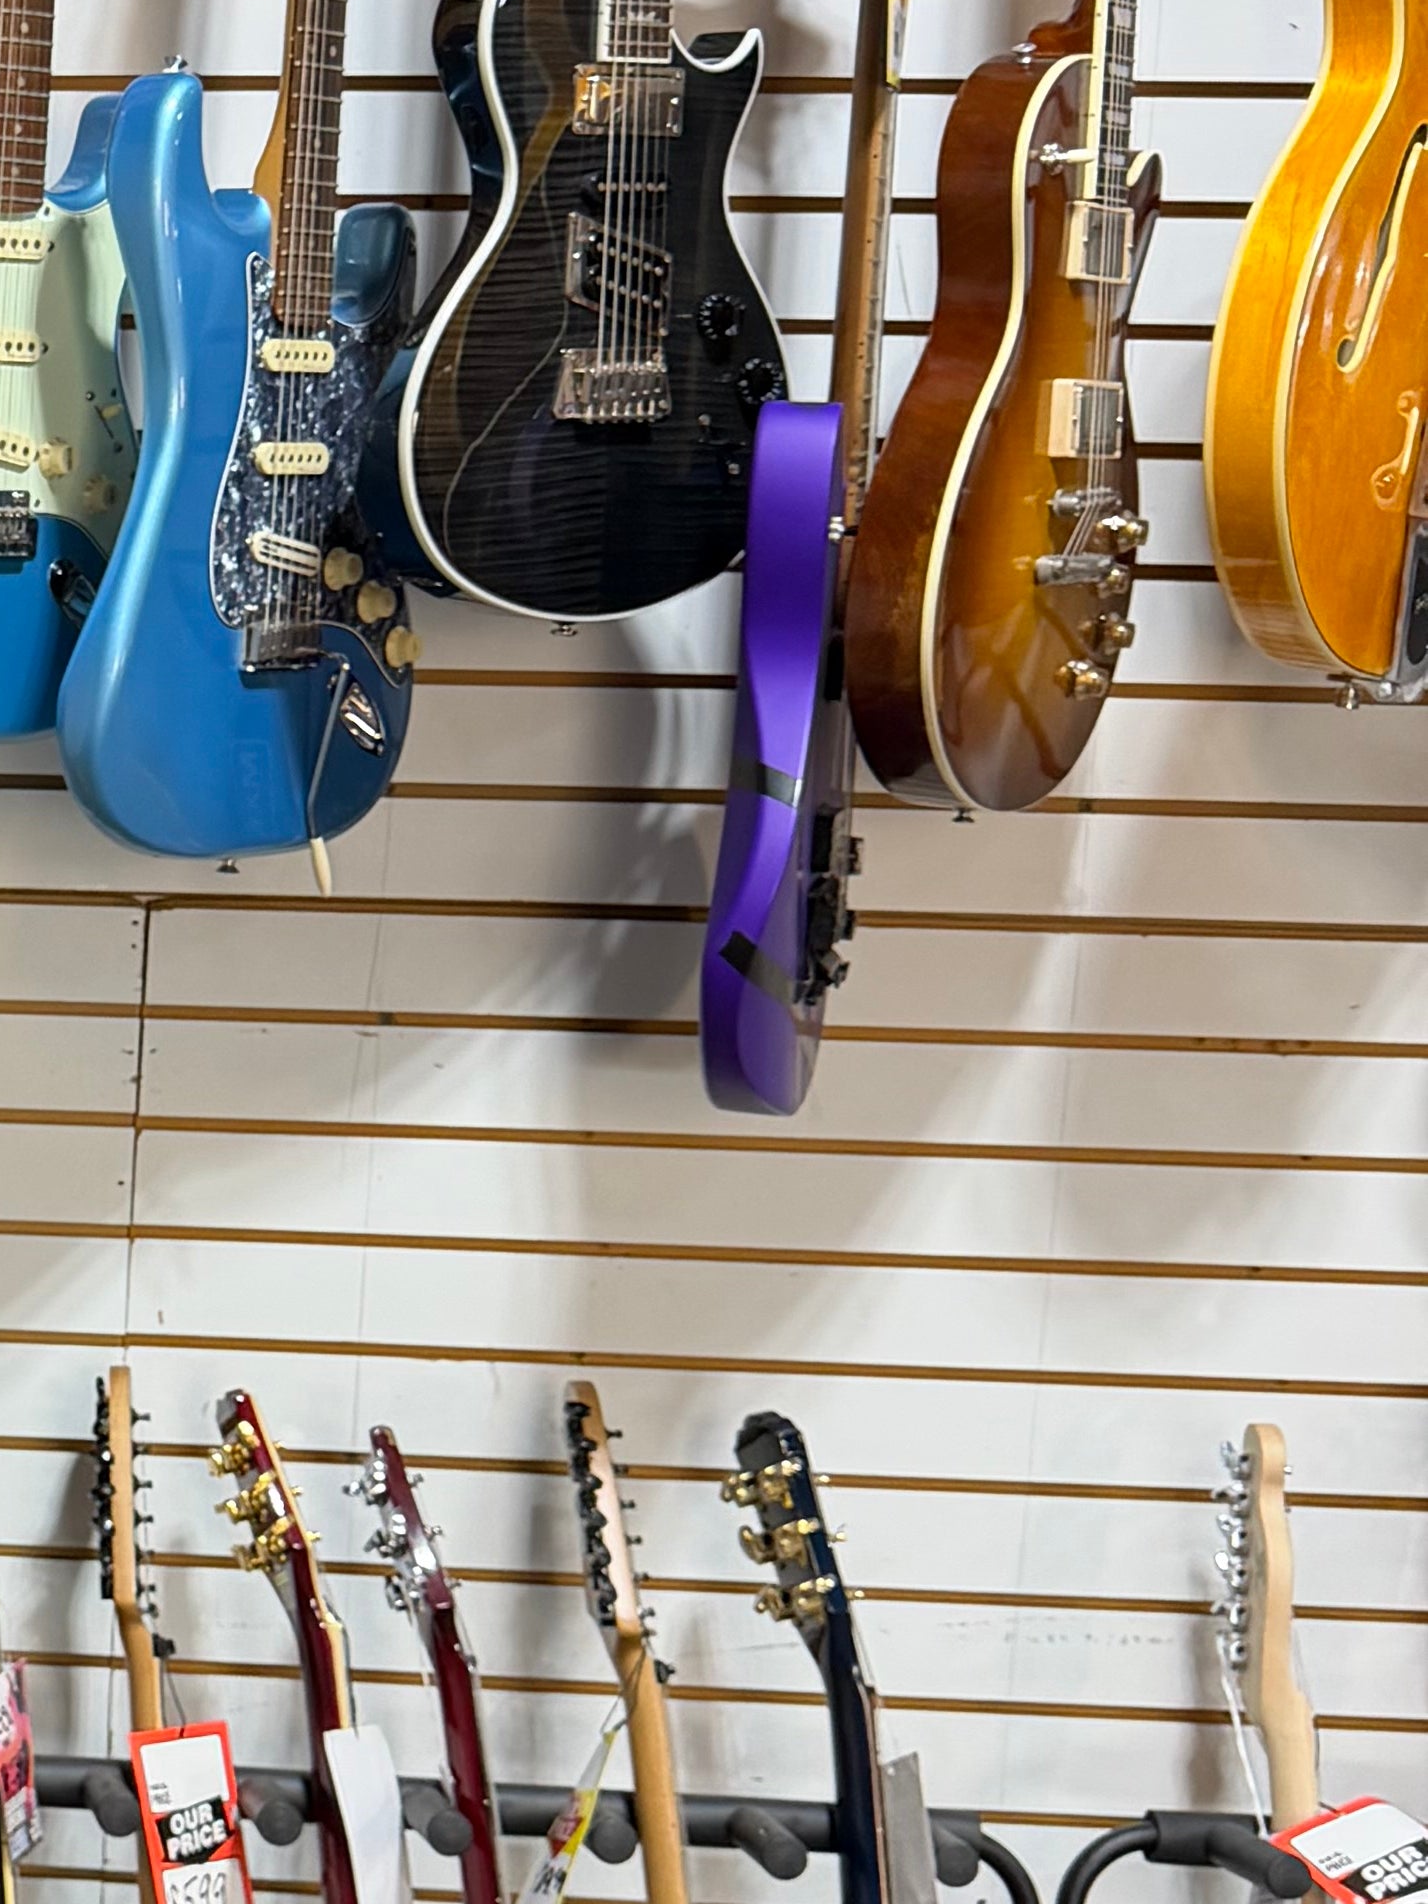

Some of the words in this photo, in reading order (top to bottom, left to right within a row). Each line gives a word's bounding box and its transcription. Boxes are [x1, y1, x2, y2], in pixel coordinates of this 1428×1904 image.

[166, 1818, 228, 1861] PRICE
[169, 1803, 214, 1836] OUR
[1360, 1845, 1424, 1883] OUR
[1364, 1859, 1428, 1901] PRIC
